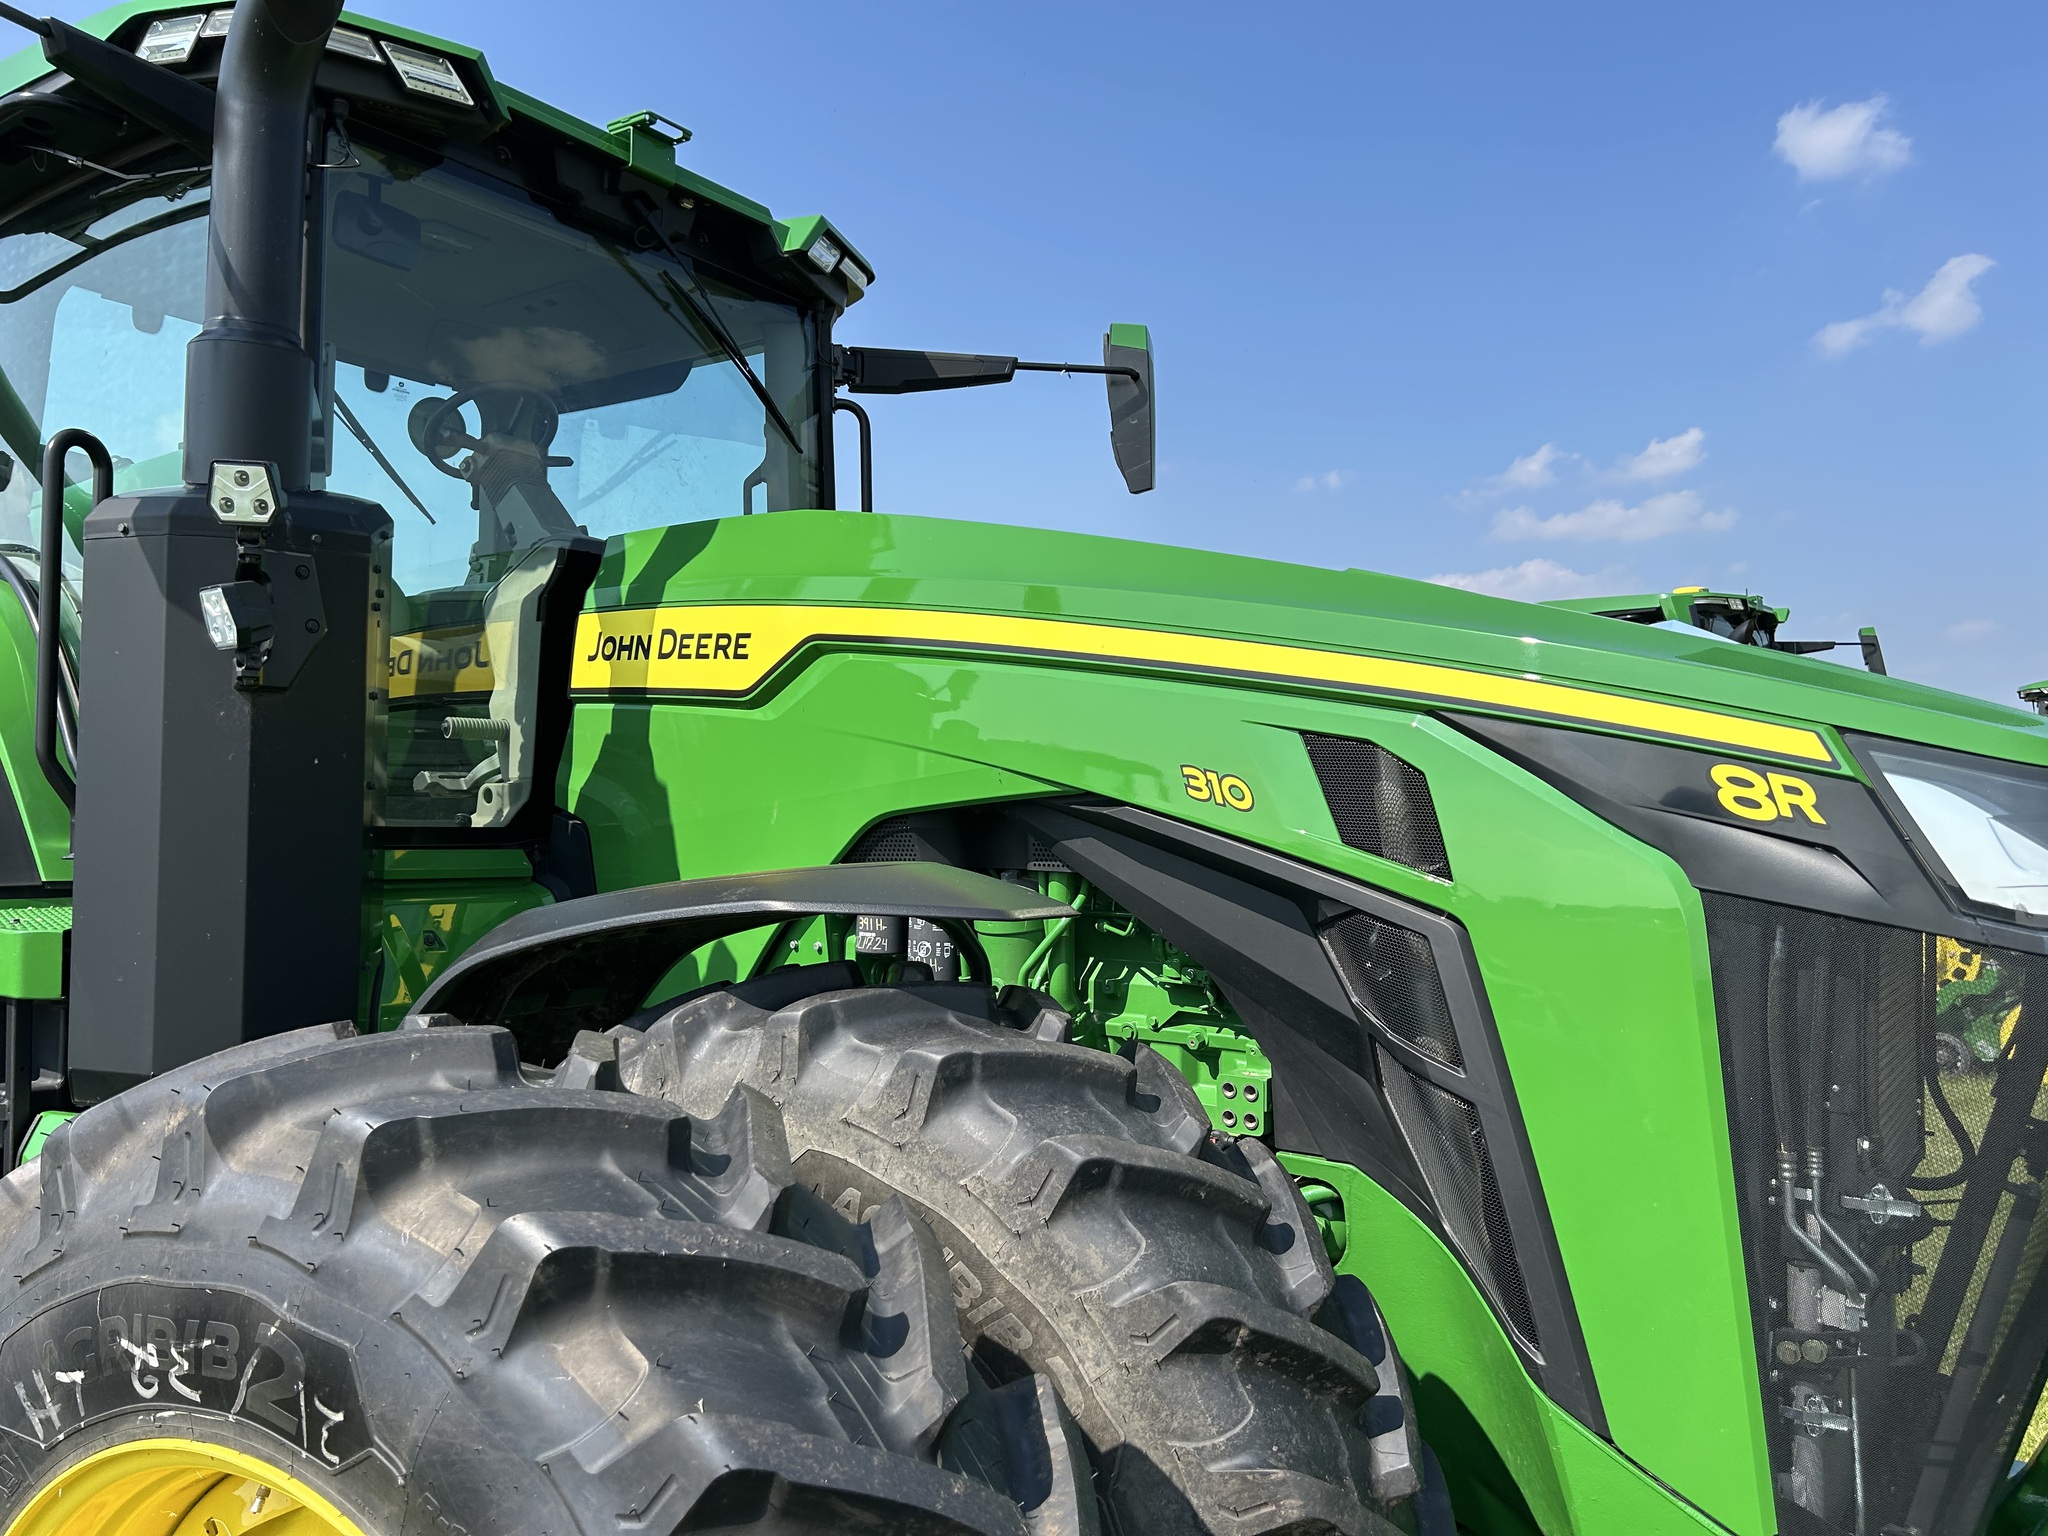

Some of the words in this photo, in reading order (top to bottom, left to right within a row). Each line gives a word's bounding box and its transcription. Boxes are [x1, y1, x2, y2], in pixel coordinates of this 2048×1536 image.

[587, 629, 653, 662] JOHN
[657, 628, 752, 661] DEERE
[1179, 763, 1255, 813] 310
[1709, 762, 1828, 826] 8R
[859, 916, 873, 930] 391
[42, 1313, 240, 1393] AGRIBIB
